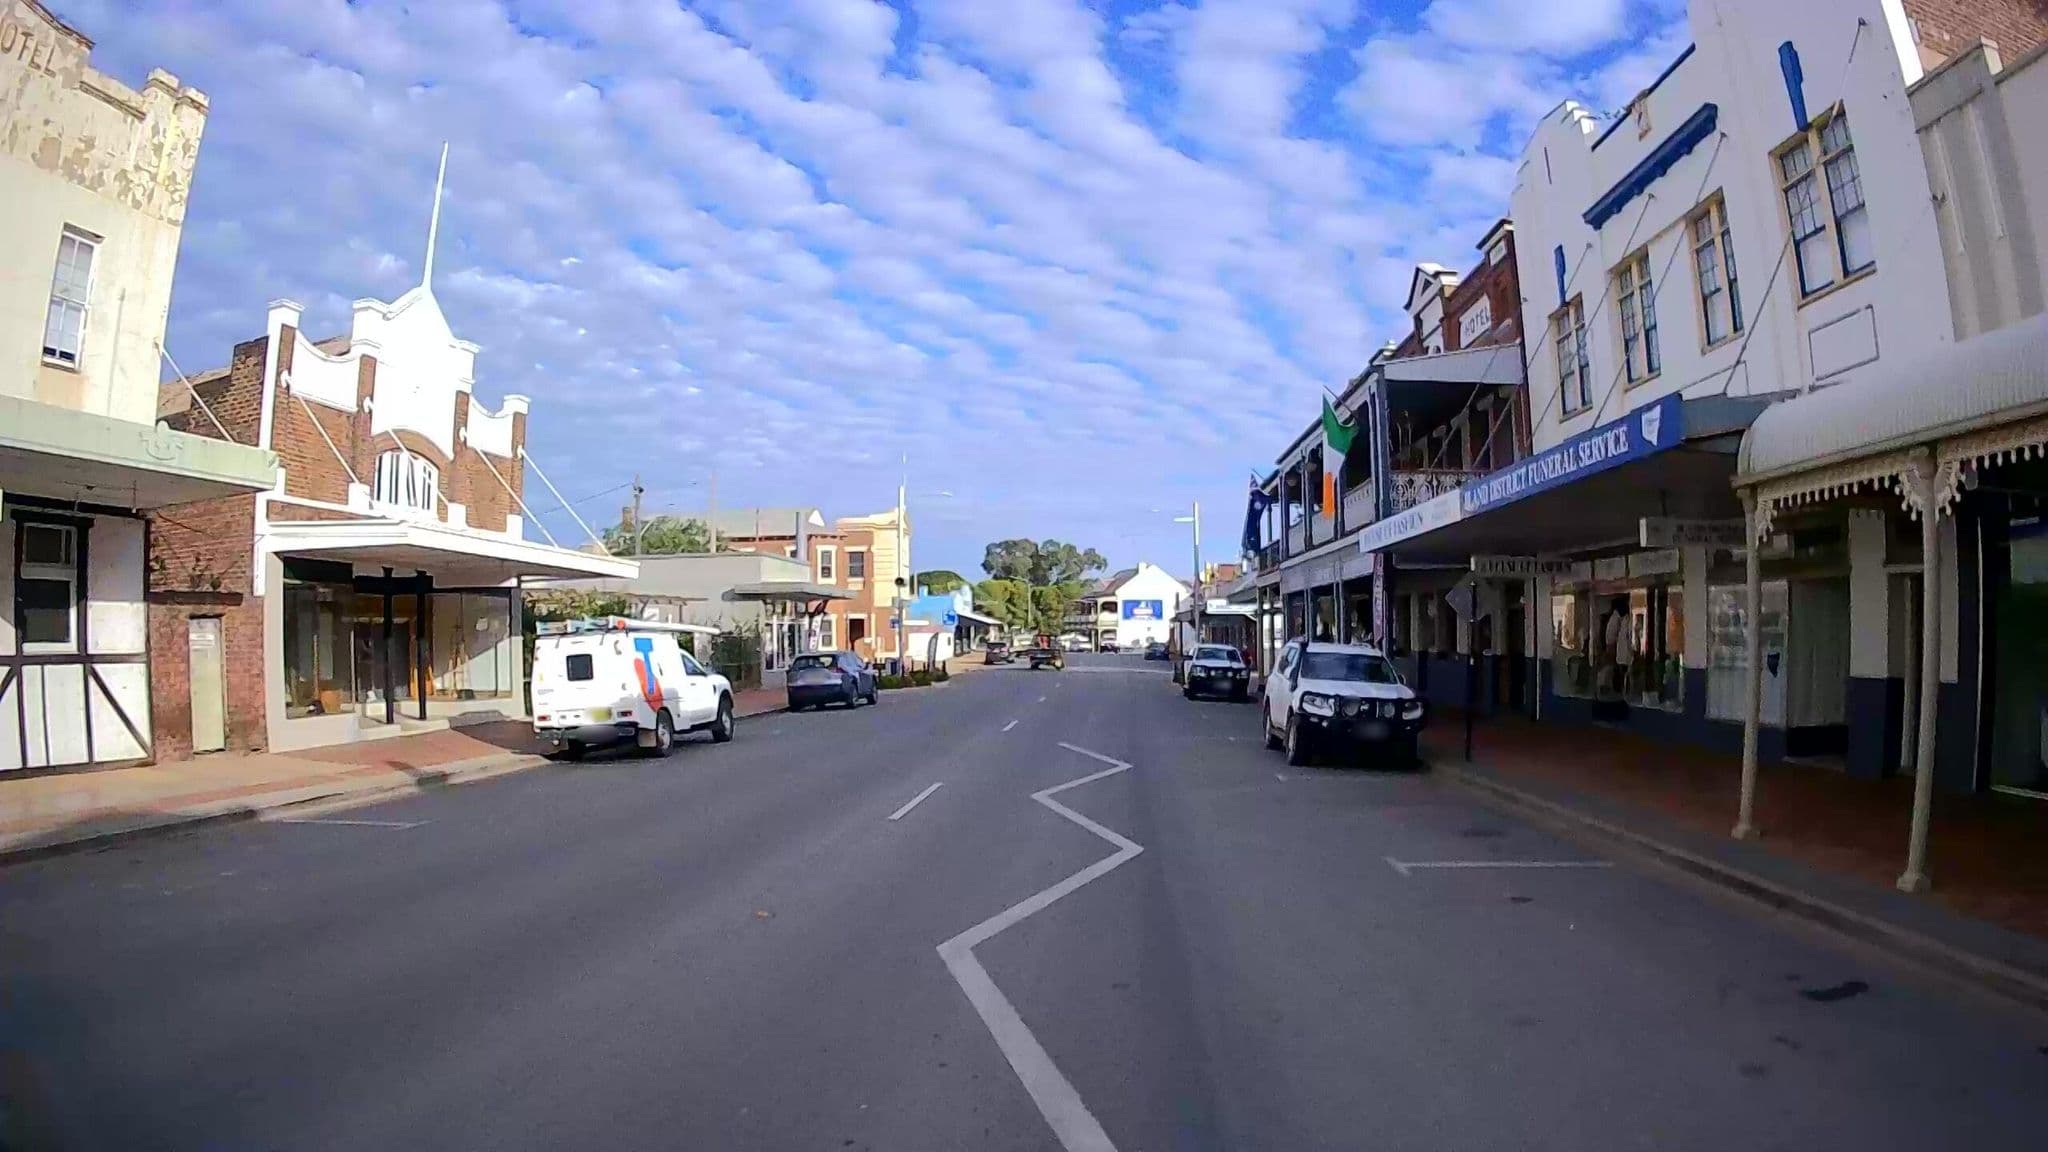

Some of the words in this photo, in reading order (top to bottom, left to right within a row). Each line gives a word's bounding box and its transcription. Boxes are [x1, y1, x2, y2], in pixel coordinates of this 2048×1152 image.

[0, 20, 57, 78] OTEL
[1489, 465, 1527, 502] DISTRICT
[1528, 446, 1577, 486] FUNERAL
[1578, 426, 1629, 467] SERVICE
